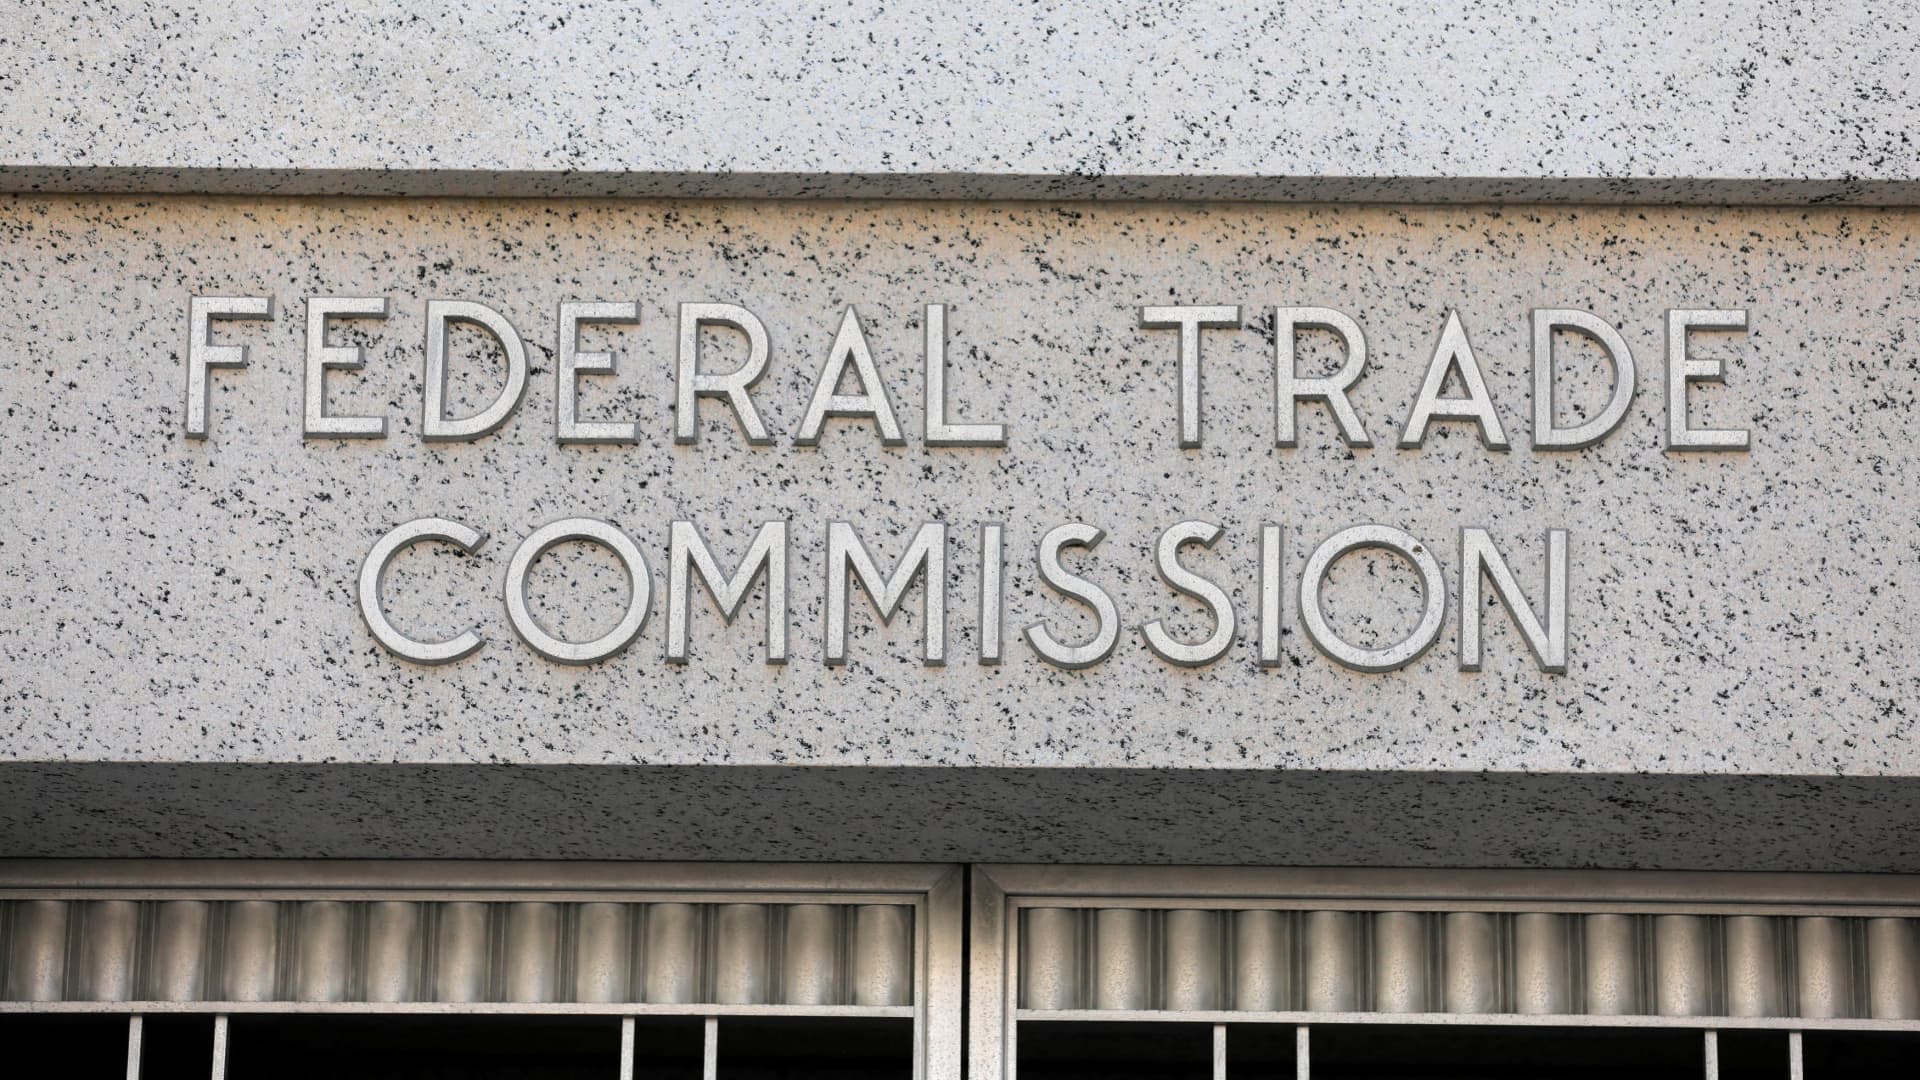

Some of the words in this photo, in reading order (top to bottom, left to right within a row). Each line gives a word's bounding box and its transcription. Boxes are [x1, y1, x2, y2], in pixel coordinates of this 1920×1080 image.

[187, 295, 1007, 448] FEDERAL
[1141, 304, 1752, 451] TRADE
[357, 517, 1570, 672] COMMISSION
